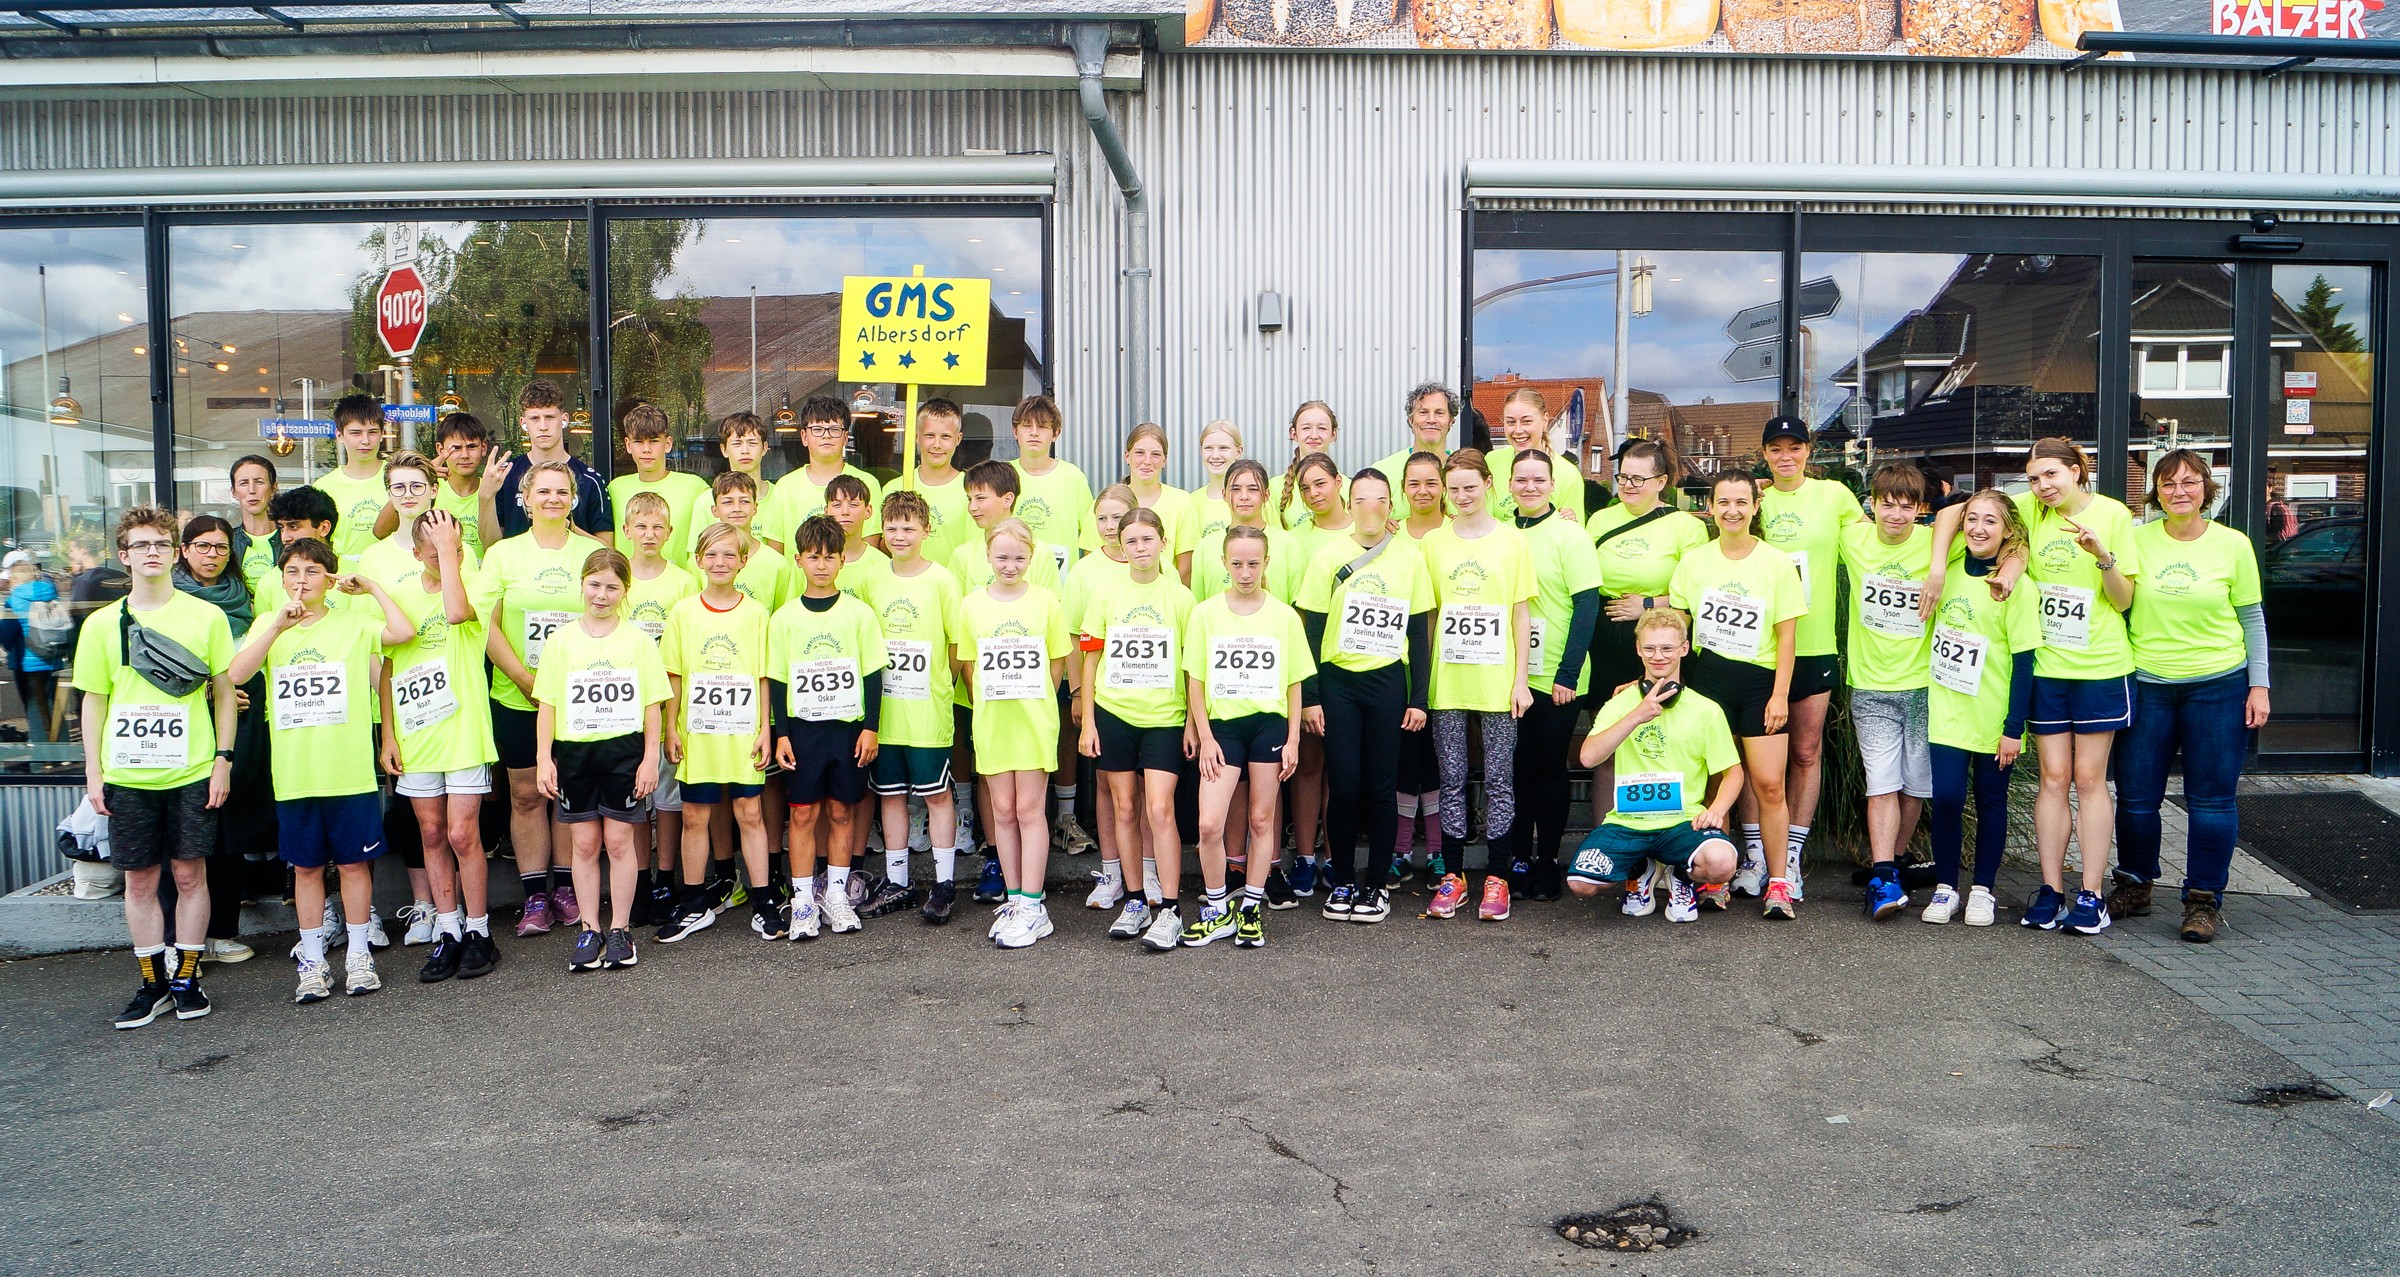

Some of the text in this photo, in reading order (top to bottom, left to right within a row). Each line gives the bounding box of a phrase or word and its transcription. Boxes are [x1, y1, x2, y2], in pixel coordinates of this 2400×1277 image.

[2212, 0, 2367, 39] BALZER
[866, 282, 955, 322] GMS
[857, 323, 971, 343] Albersdorf
[2051, 585, 2069, 593] HEIDE
[1864, 586, 1921, 611] 2635
[1346, 605, 1404, 631] 2634
[1701, 602, 1759, 631] 2622
[1883, 609, 1900, 618] Tyson
[529, 623, 557, 641] 26
[1353, 627, 1394, 640] Joelina Marie
[1445, 617, 1500, 637] 2651
[1716, 625, 1736, 637] Femke
[1947, 629, 1963, 638] HEIDE
[2047, 619, 2063, 630] Stacy
[1110, 639, 1168, 659] 2631
[1461, 638, 1482, 647] Ariane
[1933, 635, 1979, 667] 2621
[886, 653, 926, 673] 620
[983, 650, 1041, 671] 2653
[1121, 661, 1159, 670] Klementine
[1214, 650, 1276, 670] 2629
[1938, 659, 1961, 674] Lea Jolie
[408, 664, 423, 675] HEIDE
[892, 673, 903, 681] Leo
[1002, 672, 1022, 681] Frieda
[1239, 672, 1250, 680] Pia
[278, 676, 341, 700] 2652
[397, 671, 447, 706] 2628
[796, 671, 855, 694] 2639
[572, 683, 635, 704] 2609
[692, 686, 752, 706] 2617
[817, 694, 836, 703] Oskar
[295, 699, 325, 709] Friedrich
[416, 699, 431, 710] Noah
[595, 706, 613, 714] Anna
[713, 708, 732, 717] Lukas
[116, 718, 184, 738] 2646
[141, 740, 158, 749] Elias
[1626, 783, 1672, 802] 898
